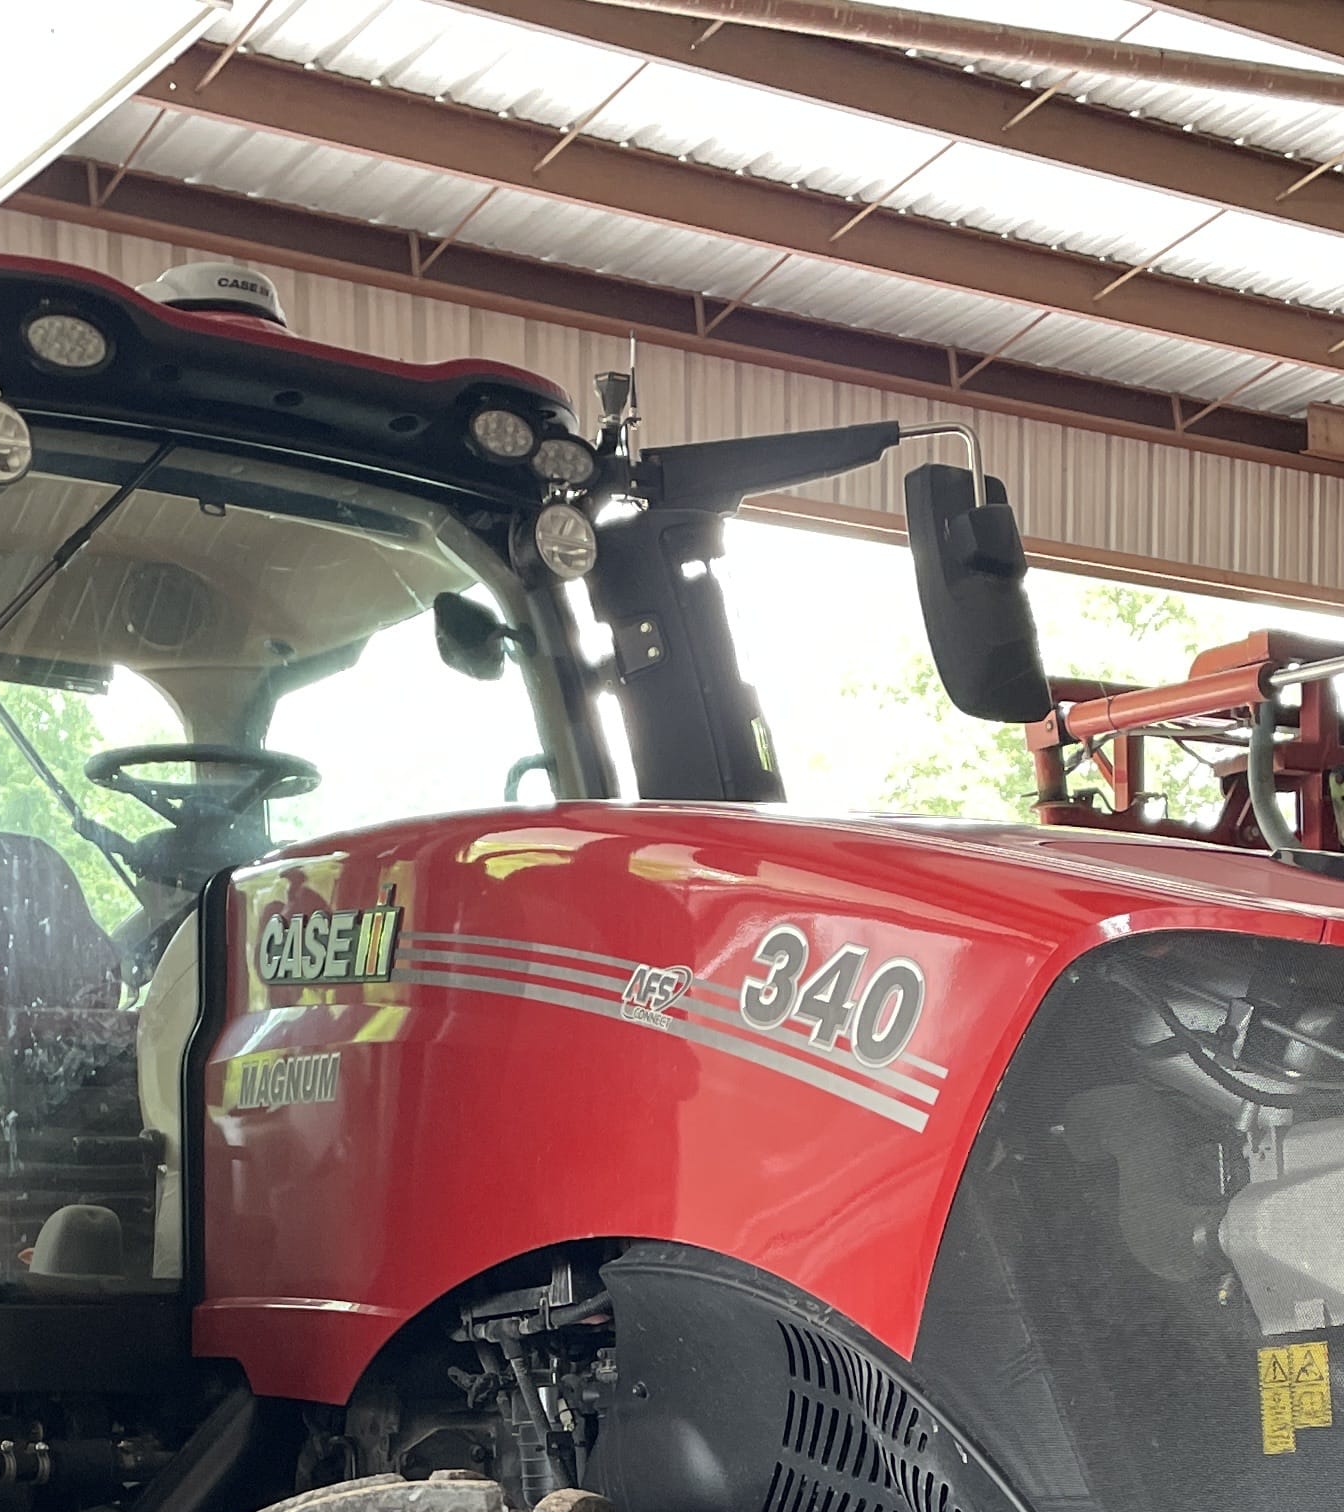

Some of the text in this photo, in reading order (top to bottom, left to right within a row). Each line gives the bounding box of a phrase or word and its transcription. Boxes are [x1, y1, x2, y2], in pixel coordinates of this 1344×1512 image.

[217, 277, 258, 292] CASE
[260, 910, 358, 981] CASE
[622, 963, 679, 1011] AFS
[739, 922, 928, 1069] 340
[237, 1052, 341, 1110] MAGNUM
